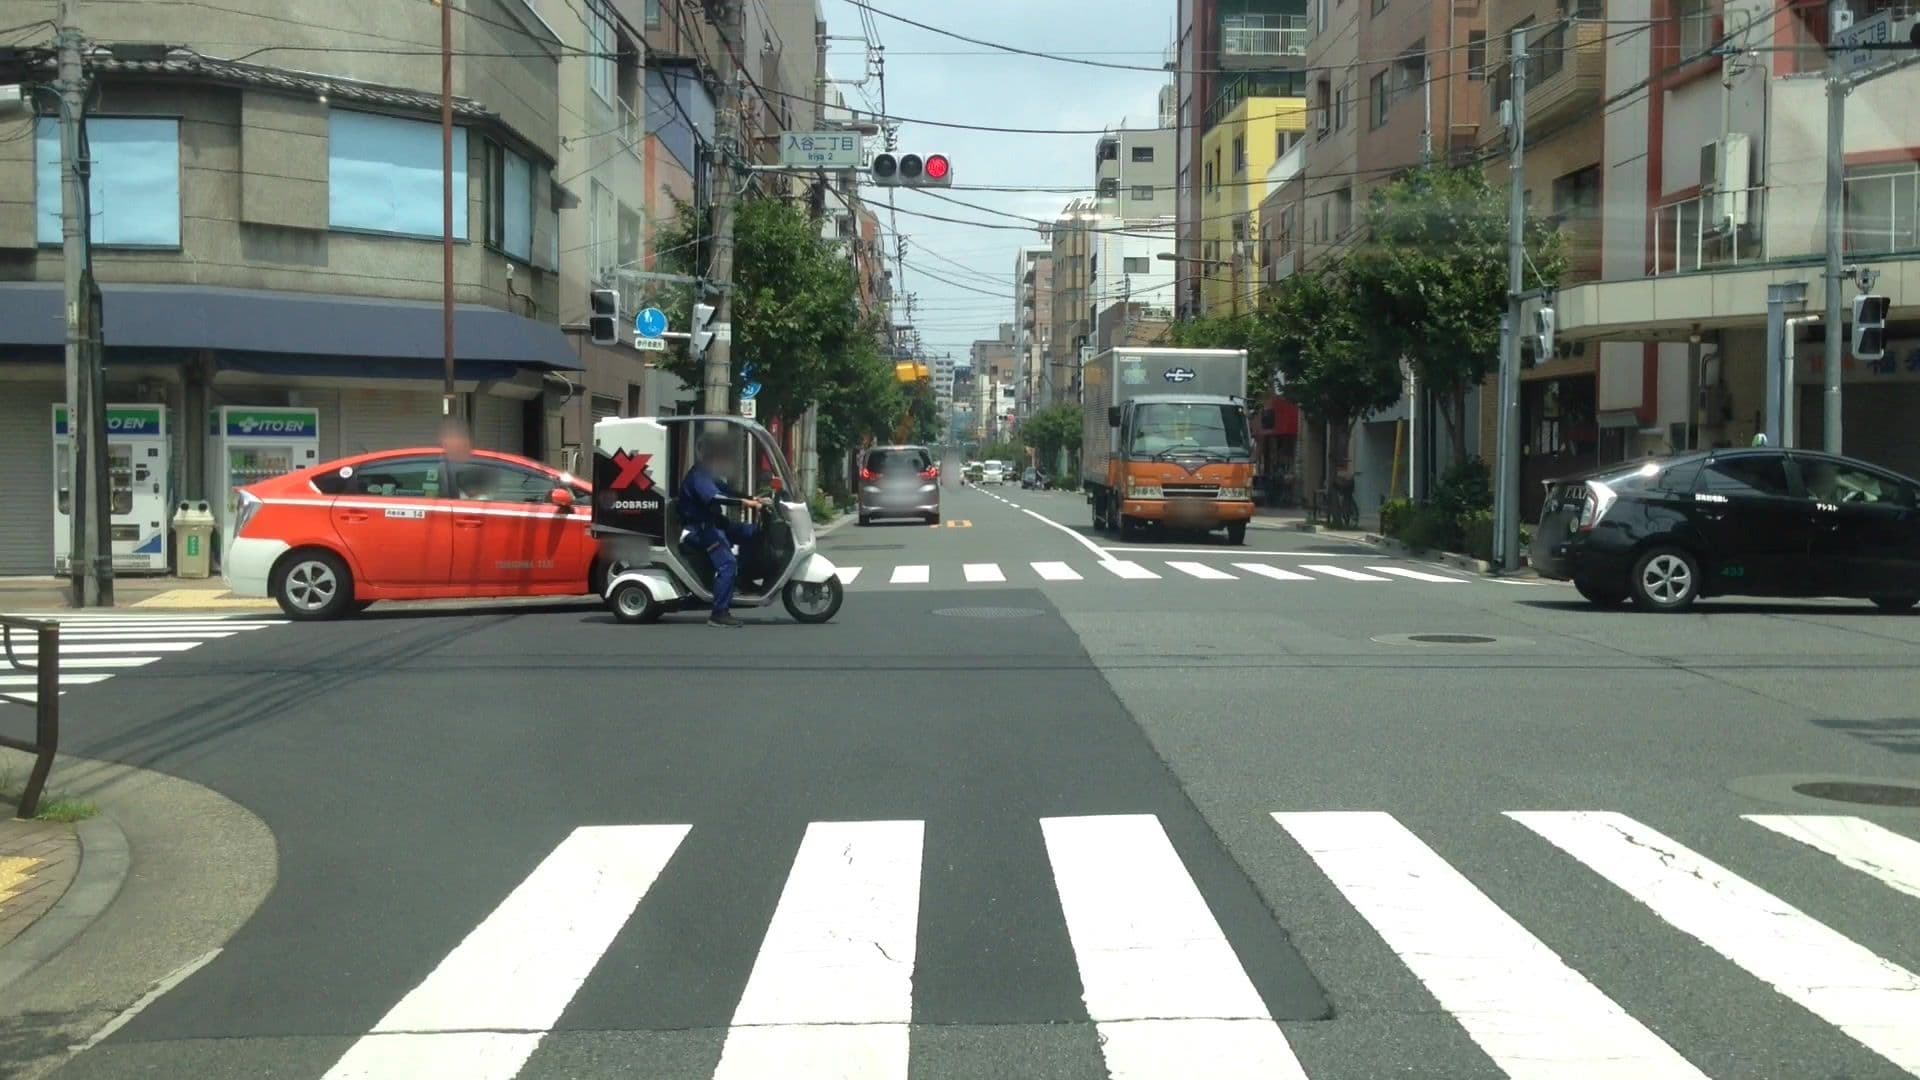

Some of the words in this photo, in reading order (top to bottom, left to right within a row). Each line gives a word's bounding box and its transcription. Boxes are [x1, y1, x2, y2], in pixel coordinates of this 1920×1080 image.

[788, 136, 854, 151] 入谷二丁目
[827, 152, 833, 161] 2
[124, 418, 146, 429] EN
[259, 419, 283, 432] ITO
[285, 420, 305, 432] EN
